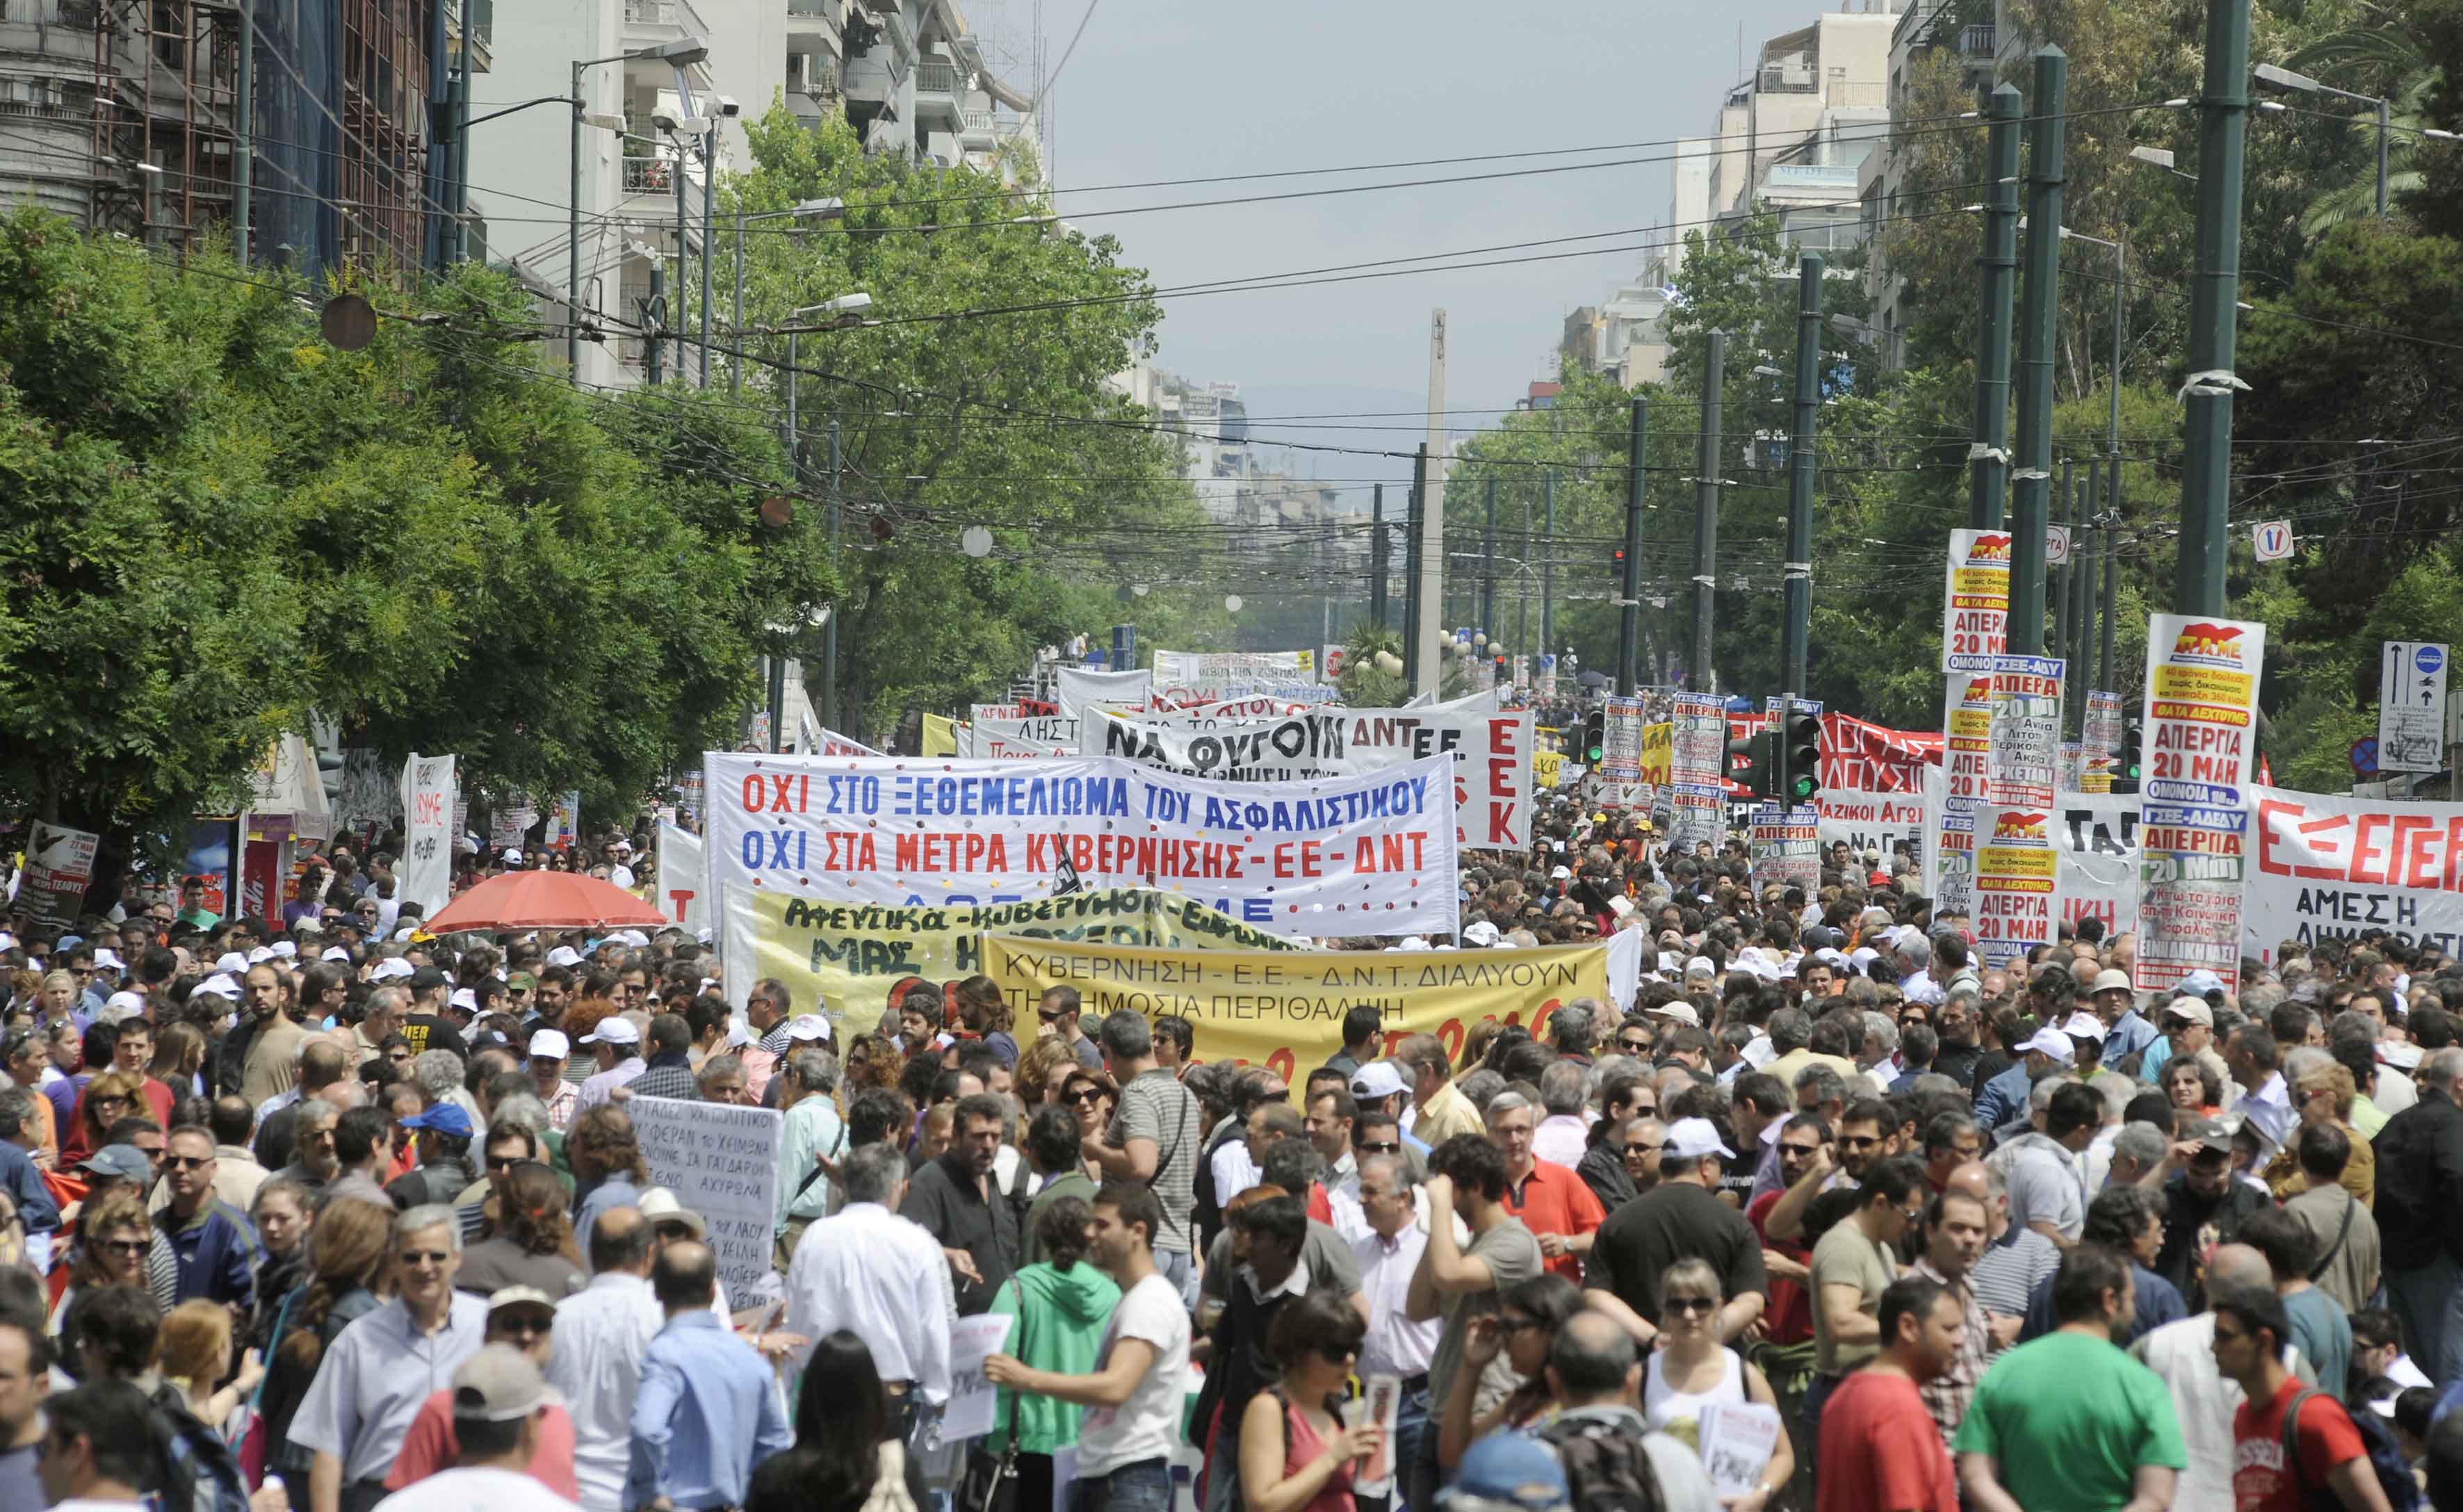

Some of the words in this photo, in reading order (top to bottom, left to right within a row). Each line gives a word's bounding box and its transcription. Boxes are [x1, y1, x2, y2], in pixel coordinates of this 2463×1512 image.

[1953, 634, 1980, 654] 20
[1951, 656, 1990, 669] ΟΜΟΝΟ
[1996, 699, 2024, 719] 20
[1018, 719, 1079, 741] ΛΗΣΤ
[1105, 720, 1167, 763] ΝΑ
[1351, 717, 1421, 747] ΔΝΤ
[2155, 723, 2241, 757] ΑΠΕΡΓΙΑ
[2152, 751, 2184, 779] 20
[2191, 755, 2239, 785] ΜΑΗ
[742, 774, 809, 813] ΟΧΙ
[826, 775, 879, 815] ΣΤΟ
[895, 775, 1129, 818] ΞΕΘΕΜΕΛΙΩΜΑ
[1144, 782, 1192, 824] ΤΟΥ
[1205, 775, 1429, 832] ΑΣΦΑΛΙΣΤΙΚΟΥ
[2149, 781, 2209, 802] ΟΜΟΝΟΙΑ
[1754, 826, 1816, 839] ΑΠΕΡΓΙΑ
[742, 829, 807, 870] ΟΧΙ
[824, 831, 877, 872] ΣΤΑ
[895, 833, 1008, 872] ΜΕΤΡΑ
[1761, 843, 1780, 859] 20
[2148, 857, 2178, 884] 20
[1979, 894, 2049, 918] ΑΠΕΡΓΙΑ
[2295, 887, 2416, 927] ΑΜΕΣΗ
[1978, 917, 2001, 938] 20
[2007, 919, 2048, 940] ΜΑΗ
[811, 936, 922, 975] ΜΑΣ
[1006, 953, 1201, 984] ΚΥΒΕΡΝΗΣΗ
[1235, 964, 1291, 985] Ε.Ε.
[1322, 965, 1408, 988] Δ.Ν.Τ.
[1418, 963, 1578, 988] ΔΙΑΛΥΟΥΝ
[1005, 989, 1043, 1012] ΤΗ
[1078, 991, 1202, 1018] ΗΜΟΣΙΑ
